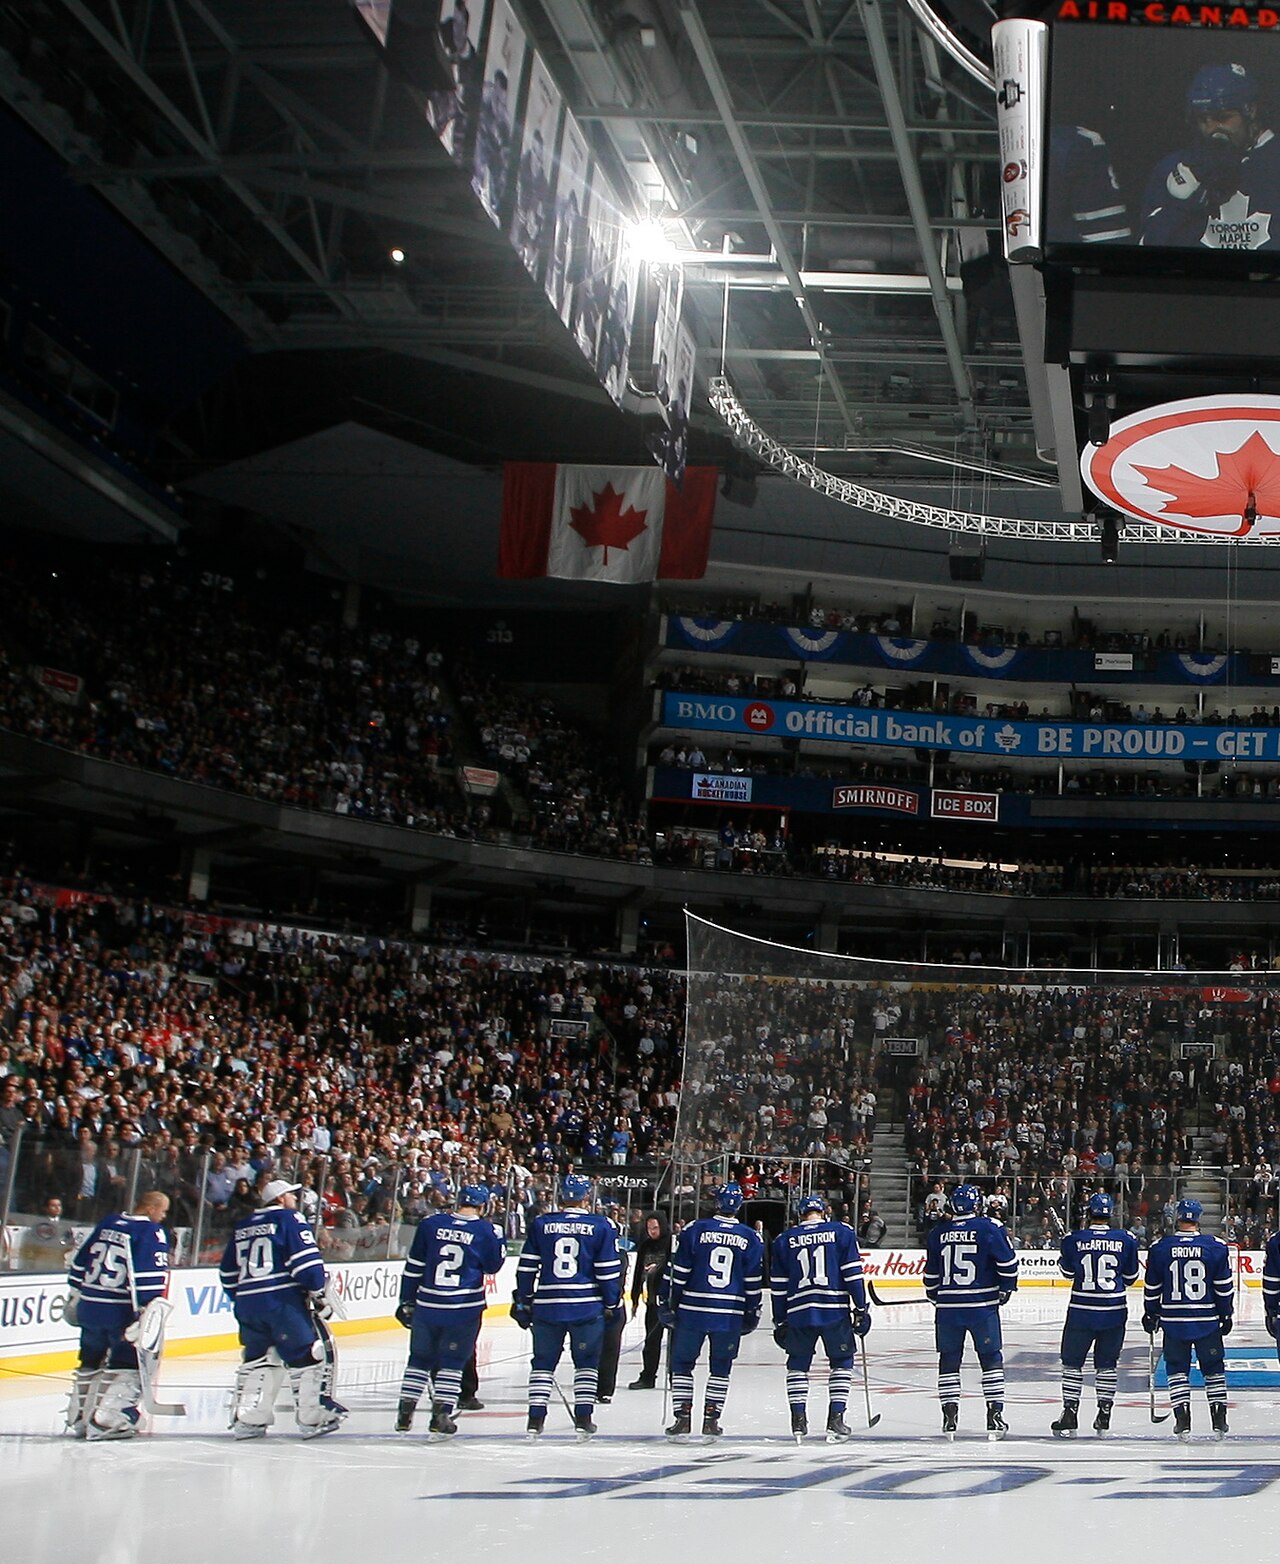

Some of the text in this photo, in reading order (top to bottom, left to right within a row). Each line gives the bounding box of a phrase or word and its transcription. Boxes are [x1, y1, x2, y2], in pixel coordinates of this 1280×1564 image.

[1060, 1, 1128, 20] AIR
[1209, 222, 1260, 234] TORONTO
[1219, 232, 1252, 243] MAPLE
[677, 701, 737, 722] BMO
[785, 710, 879, 739] Official
[886, 716, 953, 746] bank
[958, 725, 986, 748] of
[1037, 727, 1074, 753] BE
[1082, 728, 1186, 755] PROUD
[1216, 731, 1268, 757] GET
[837, 789, 914, 810] SMIRNOFF
[937, 797, 993, 815] ICE BOX
[888, 1041, 915, 1054] IBM
[436, 1228, 474, 1246] SCHENN
[543, 1222, 595, 1237] KOMISAREK
[940, 1230, 978, 1243] KABERLE
[85, 1241, 127, 1288] 35
[235, 1237, 274, 1285] 50
[434, 1243, 465, 1288] 2
[552, 1236, 580, 1280] 8
[883, 1252, 927, 1276] Hort
[940, 1244, 979, 1287] 15
[1018, 1256, 1060, 1268] terho
[1171, 1246, 1202, 1259] BROWN
[707, 1246, 735, 1289] 9
[797, 1245, 829, 1289] 11
[1080, 1253, 1119, 1292] 16
[1168, 1259, 1208, 1301] 18
[342, 1267, 399, 1302] kerSta
[184, 1285, 233, 1316] VIA
